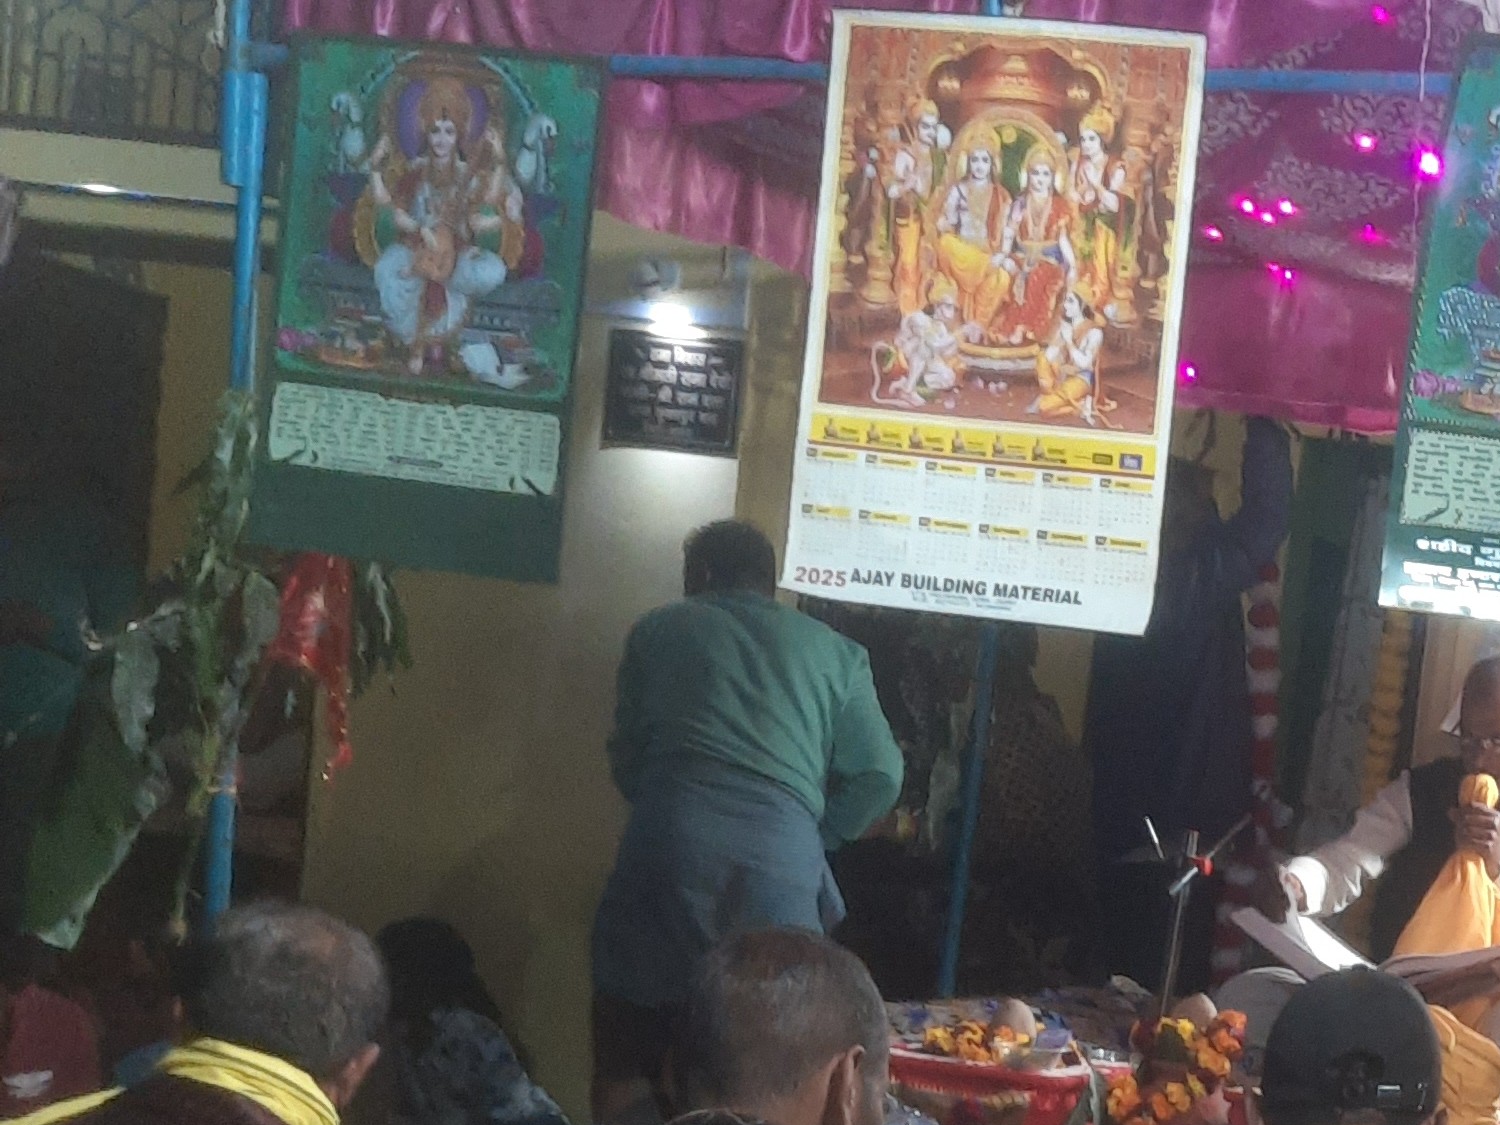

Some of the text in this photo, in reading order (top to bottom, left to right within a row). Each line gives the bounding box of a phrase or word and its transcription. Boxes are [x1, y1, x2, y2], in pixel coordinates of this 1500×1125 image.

[793, 566, 847, 588] 2025
[850, 567, 896, 588] AJAY
[900, 572, 988, 597] BUILDING
[992, 581, 1083, 605] MATERIAL
